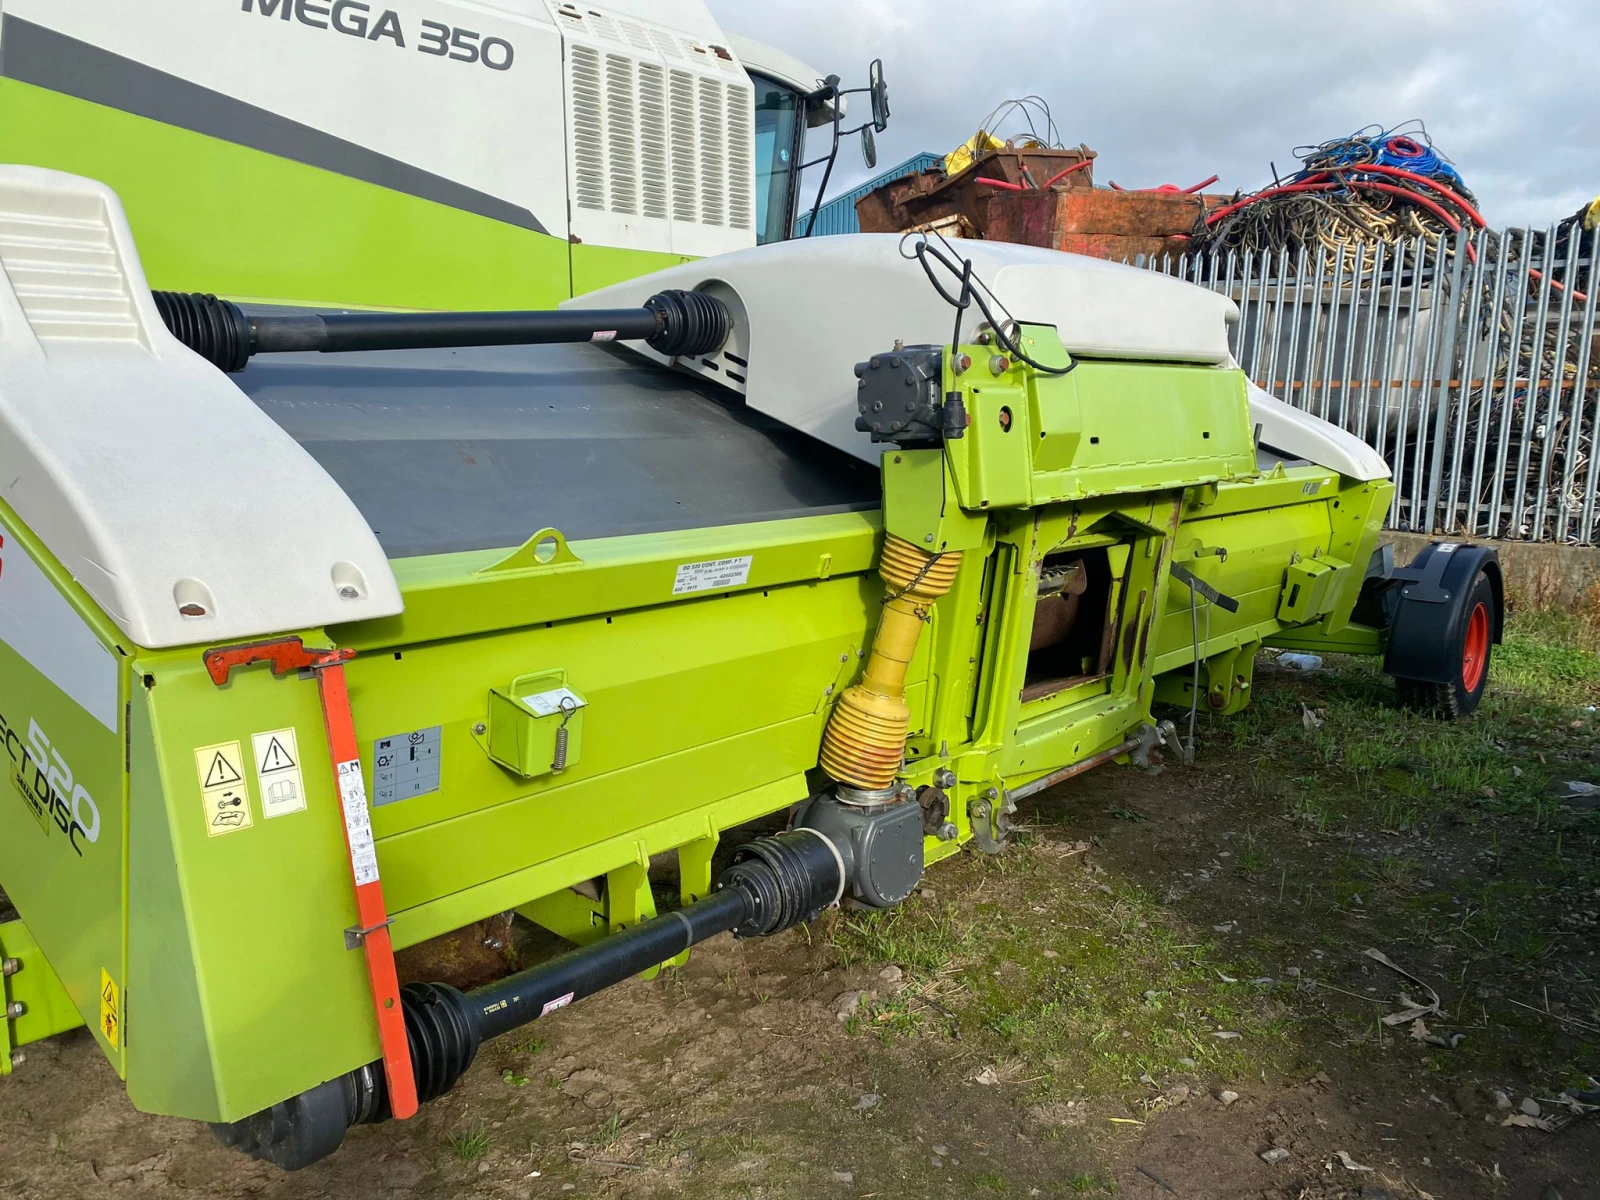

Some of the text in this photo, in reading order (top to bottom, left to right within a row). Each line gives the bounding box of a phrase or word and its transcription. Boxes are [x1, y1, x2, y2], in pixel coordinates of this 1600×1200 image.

[241, 0, 514, 71] MEGA 350
[26, 716, 100, 843] 520
[34, 767, 86, 858] DISC
